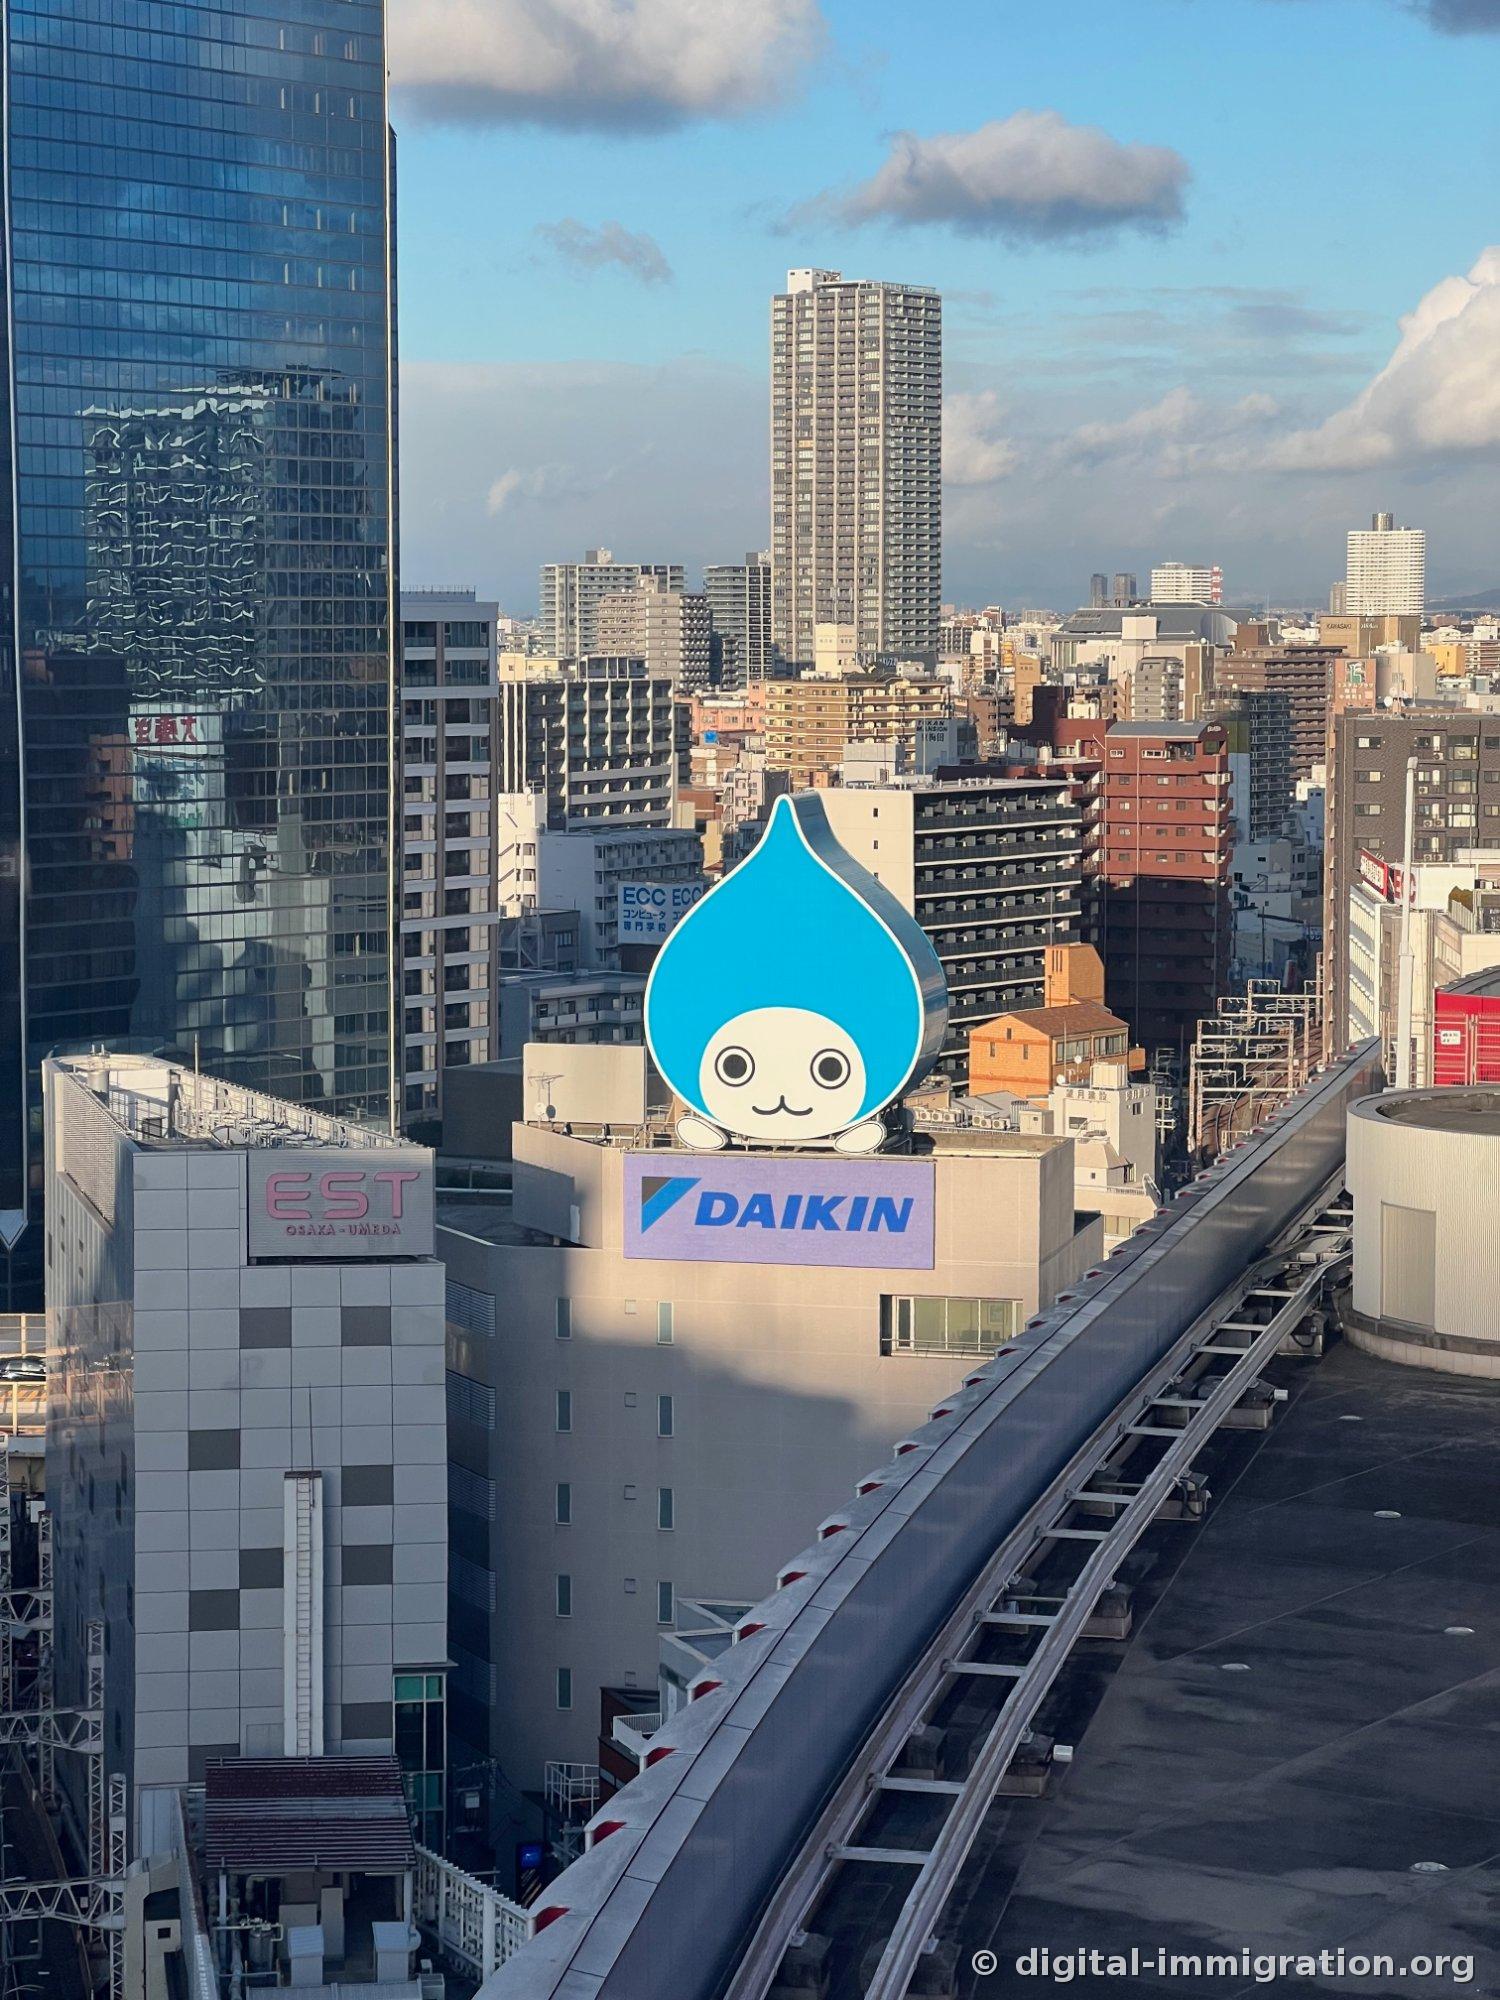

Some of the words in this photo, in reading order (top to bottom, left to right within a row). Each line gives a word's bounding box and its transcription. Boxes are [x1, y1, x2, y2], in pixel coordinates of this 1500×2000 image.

[623, 886, 666, 906] ECC
[623, 909, 666, 920] コンピュータ
[623, 921, 667, 932] 専門学校
[265, 1171, 421, 1220] EST
[694, 1191, 914, 1233] DAIKIN
